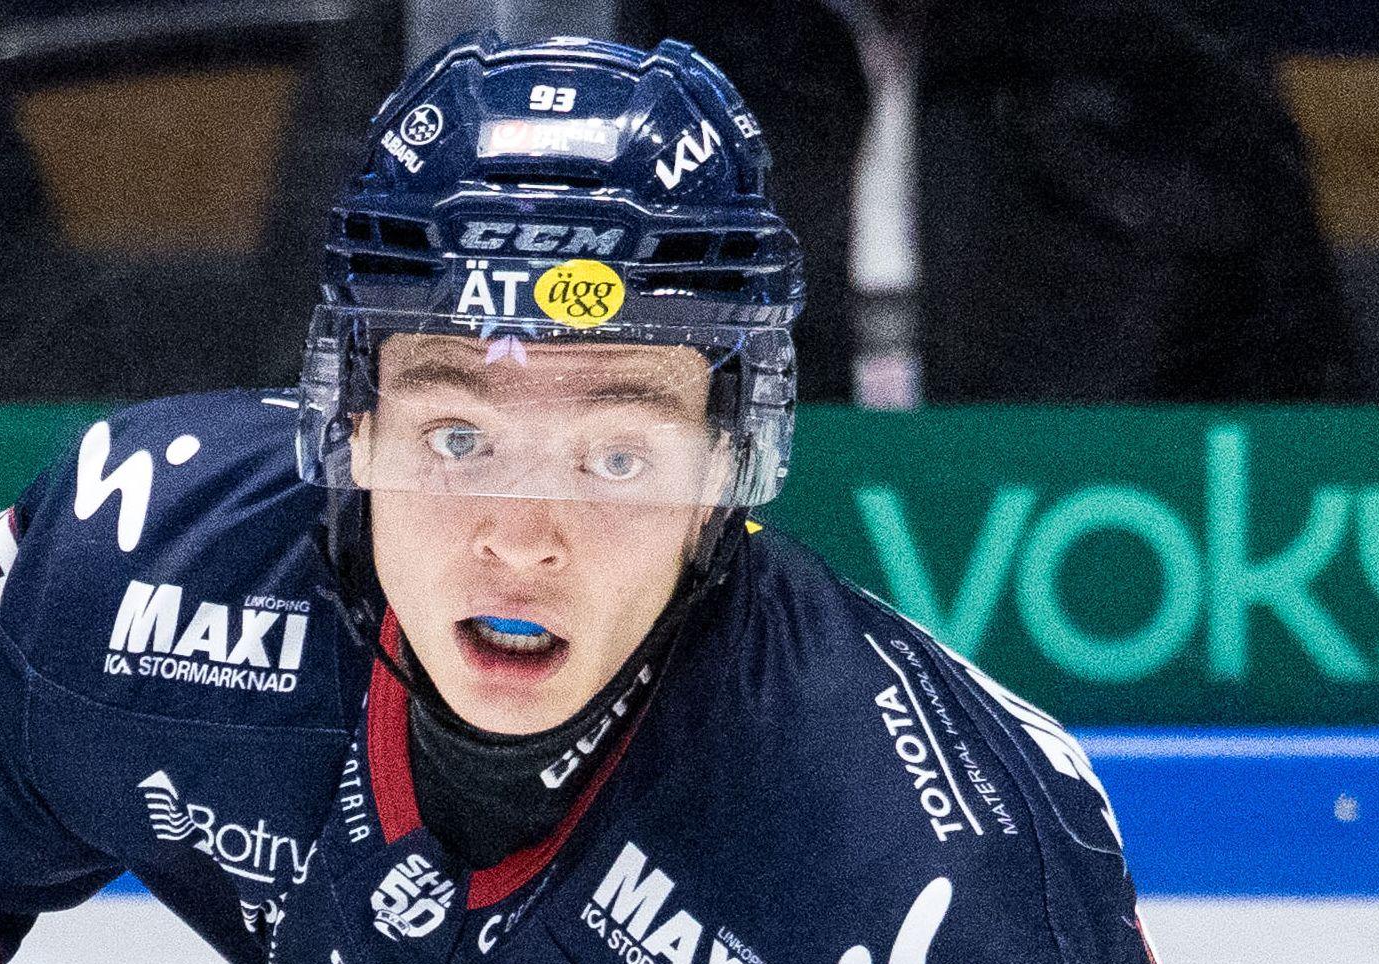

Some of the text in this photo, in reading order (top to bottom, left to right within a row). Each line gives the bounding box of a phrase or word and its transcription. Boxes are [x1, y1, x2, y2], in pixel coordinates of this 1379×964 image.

[529, 85, 576, 112] 93
[381, 130, 424, 174] SUBARU
[458, 221, 624, 255] CCM
[456, 259, 616, 318] ÄT ägg
[109, 580, 308, 670] MAXI
[137, 655, 298, 693] STORMARKNAD
[874, 685, 963, 842] TOYOTA
[952, 741, 1019, 836] MATERIAL
[580, 903, 607, 939] ICA
